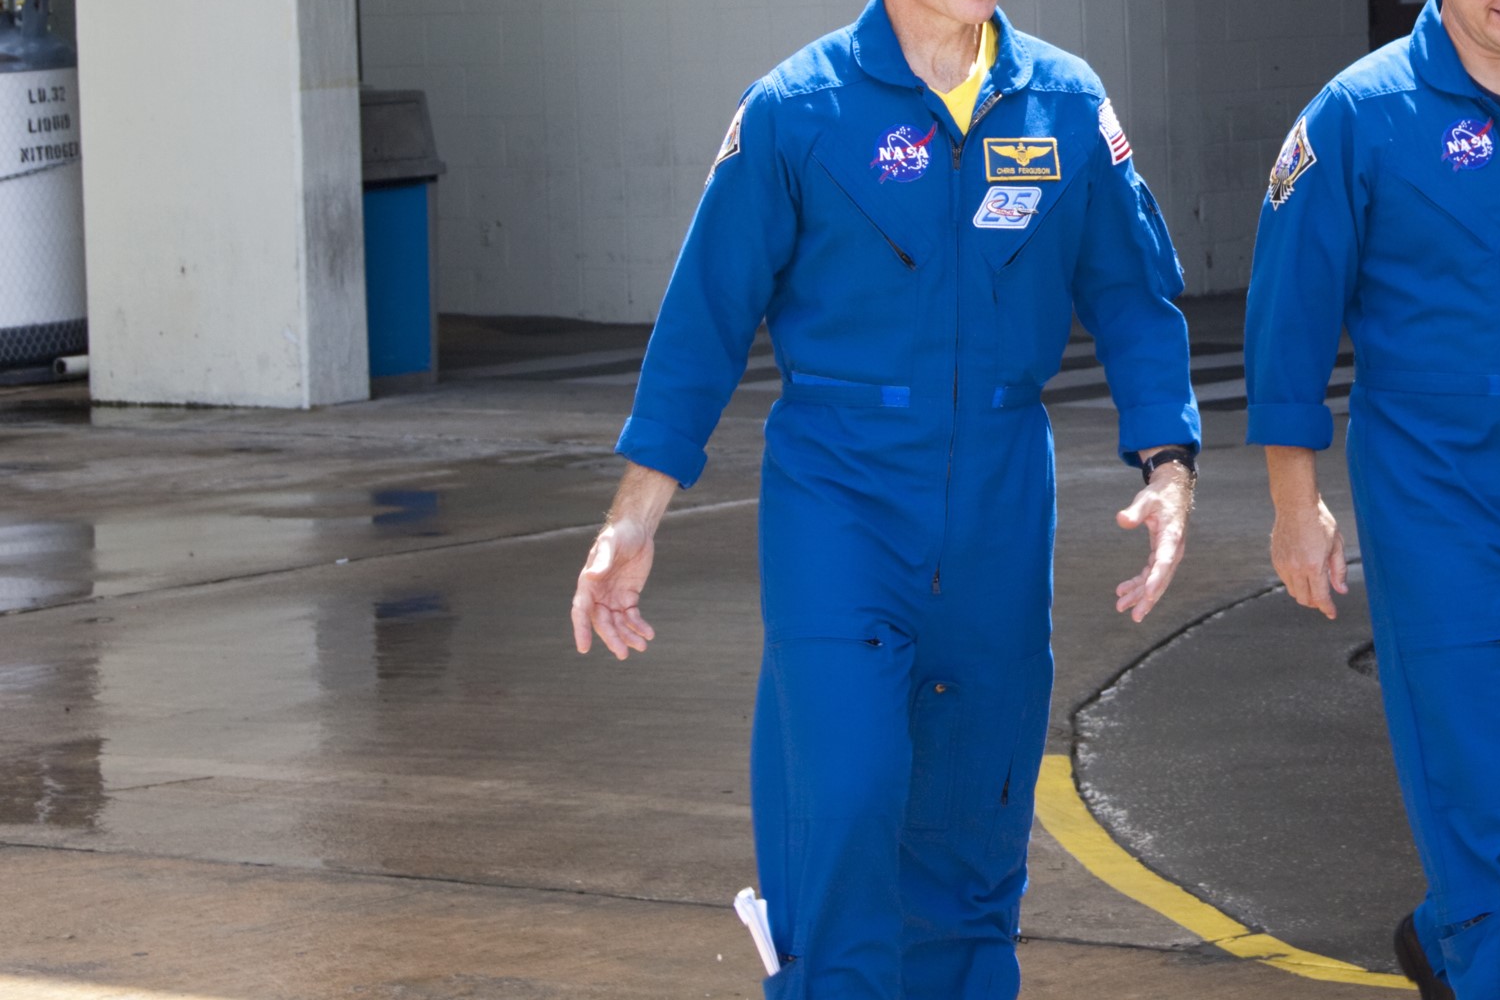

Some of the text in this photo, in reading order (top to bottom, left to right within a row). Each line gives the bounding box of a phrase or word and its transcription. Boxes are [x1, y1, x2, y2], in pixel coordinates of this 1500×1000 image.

[28, 114, 71, 133] LIQUID
[879, 145, 929, 162] NASA
[1447, 134, 1492, 154] NASA
[996, 167, 1051, 175] CHRIS FERGUSON
[982, 192, 1032, 222] 25
